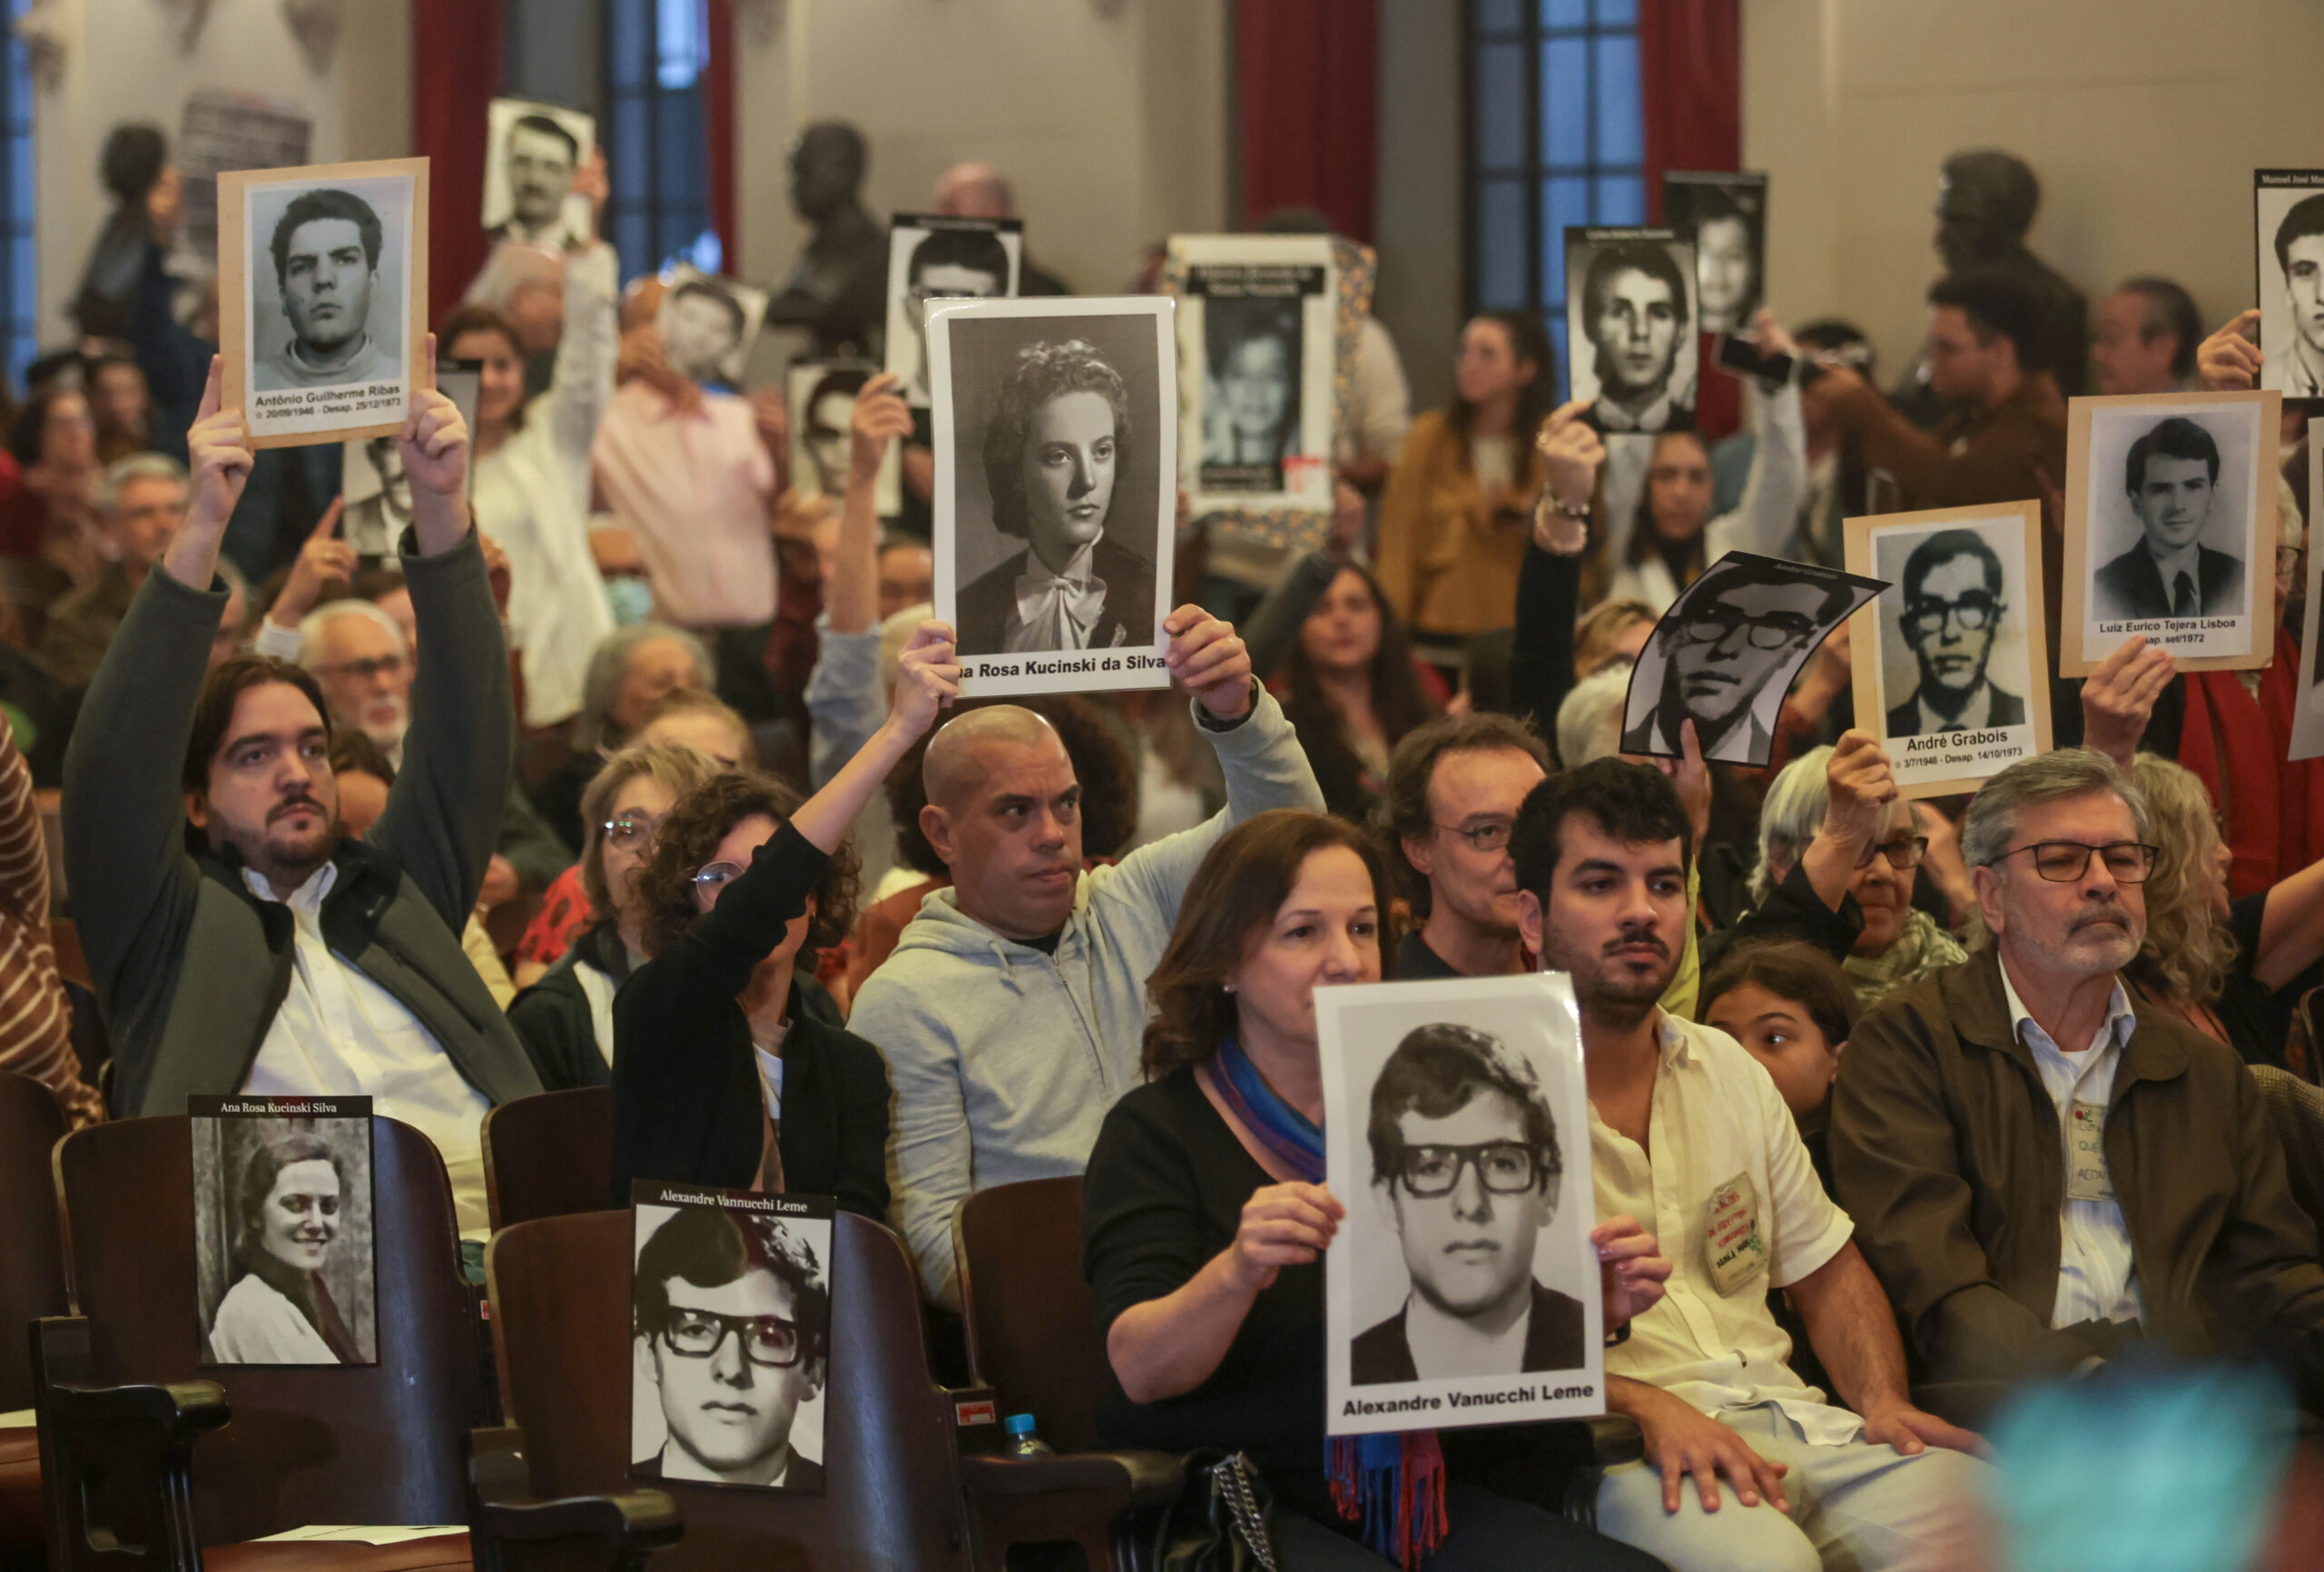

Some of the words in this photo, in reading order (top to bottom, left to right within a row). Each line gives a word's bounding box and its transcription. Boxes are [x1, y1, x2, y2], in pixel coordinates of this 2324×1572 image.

[255, 396, 302, 408] Antônio
[307, 390, 365, 403] Guilherme
[369, 385, 400, 397] Ribas
[2100, 623, 2122, 633] Luiz
[2126, 622, 2161, 632] Eurico
[2164, 621, 2196, 632] Tejera
[2201, 619, 2235, 629] Lisboa
[980, 663, 1019, 677] Rosa
[1025, 658, 1096, 675] Kucinski
[1101, 656, 1121, 672] da
[1127, 654, 1166, 670] Silva
[1906, 735, 1947, 752] André
[1952, 730, 2008, 747] Grabois
[1977, 747, 2023, 761] 14/10/1973
[221, 1103, 241, 1113] Ana
[241, 1103, 266, 1113] Rosa
[268, 1102, 311, 1113] Kucinski
[312, 1102, 337, 1113] Silva
[660, 1190, 715, 1205] Alexandre
[716, 1194, 774, 1210] Vannucchi
[776, 1200, 808, 1213] Leme
[1343, 1395, 1442, 1416] Alexandre
[1448, 1387, 1536, 1408] Vanucchi
[1541, 1384, 1594, 1400] Leme
